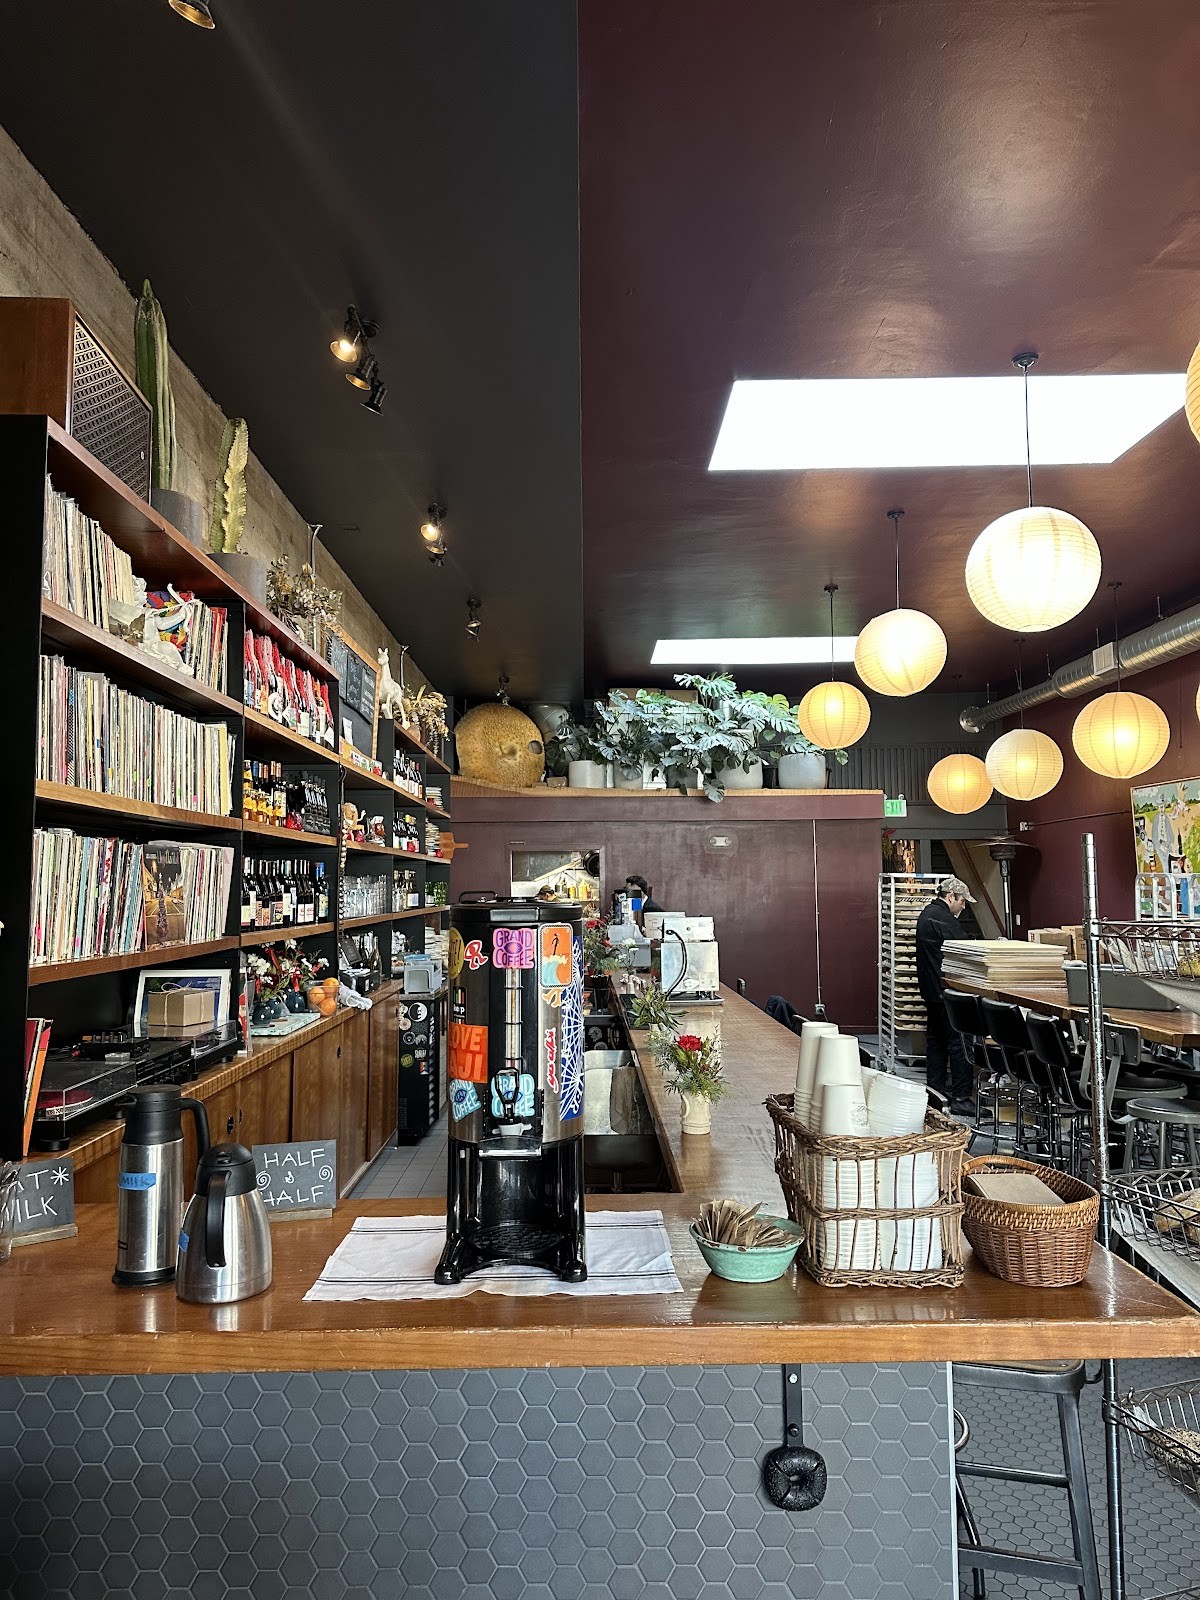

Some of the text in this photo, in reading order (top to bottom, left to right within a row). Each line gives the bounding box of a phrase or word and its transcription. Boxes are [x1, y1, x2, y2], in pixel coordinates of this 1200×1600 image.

[885, 801, 903, 815] EXIT
[495, 930, 533, 949] GRAND
[495, 948, 533, 966] COFFEE
[453, 1089, 480, 1120] COFFEE
[264, 1148, 325, 1169] HALF
[284, 1170, 295, 1184] &
